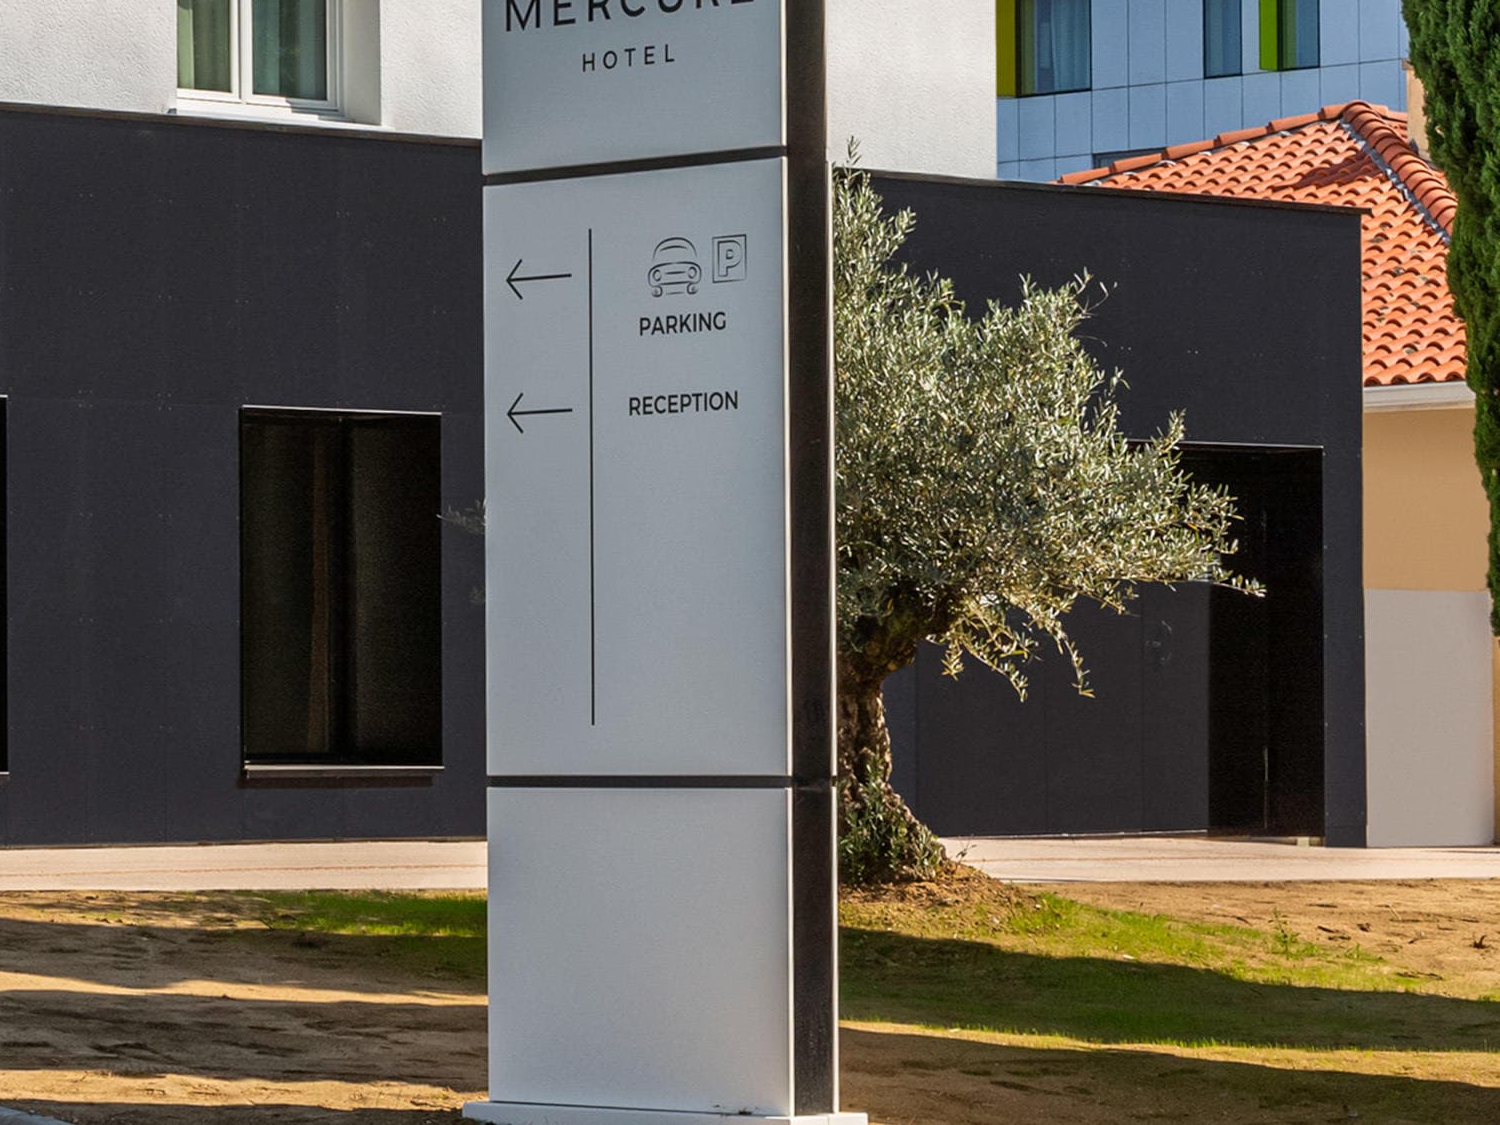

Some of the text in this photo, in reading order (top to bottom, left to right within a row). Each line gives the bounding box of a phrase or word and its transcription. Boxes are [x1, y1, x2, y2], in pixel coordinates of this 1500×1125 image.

[582, 43, 675, 73] HOTEL
[717, 239, 742, 277] P
[639, 311, 727, 336] PARKING
[628, 390, 738, 417] RECEPTION
